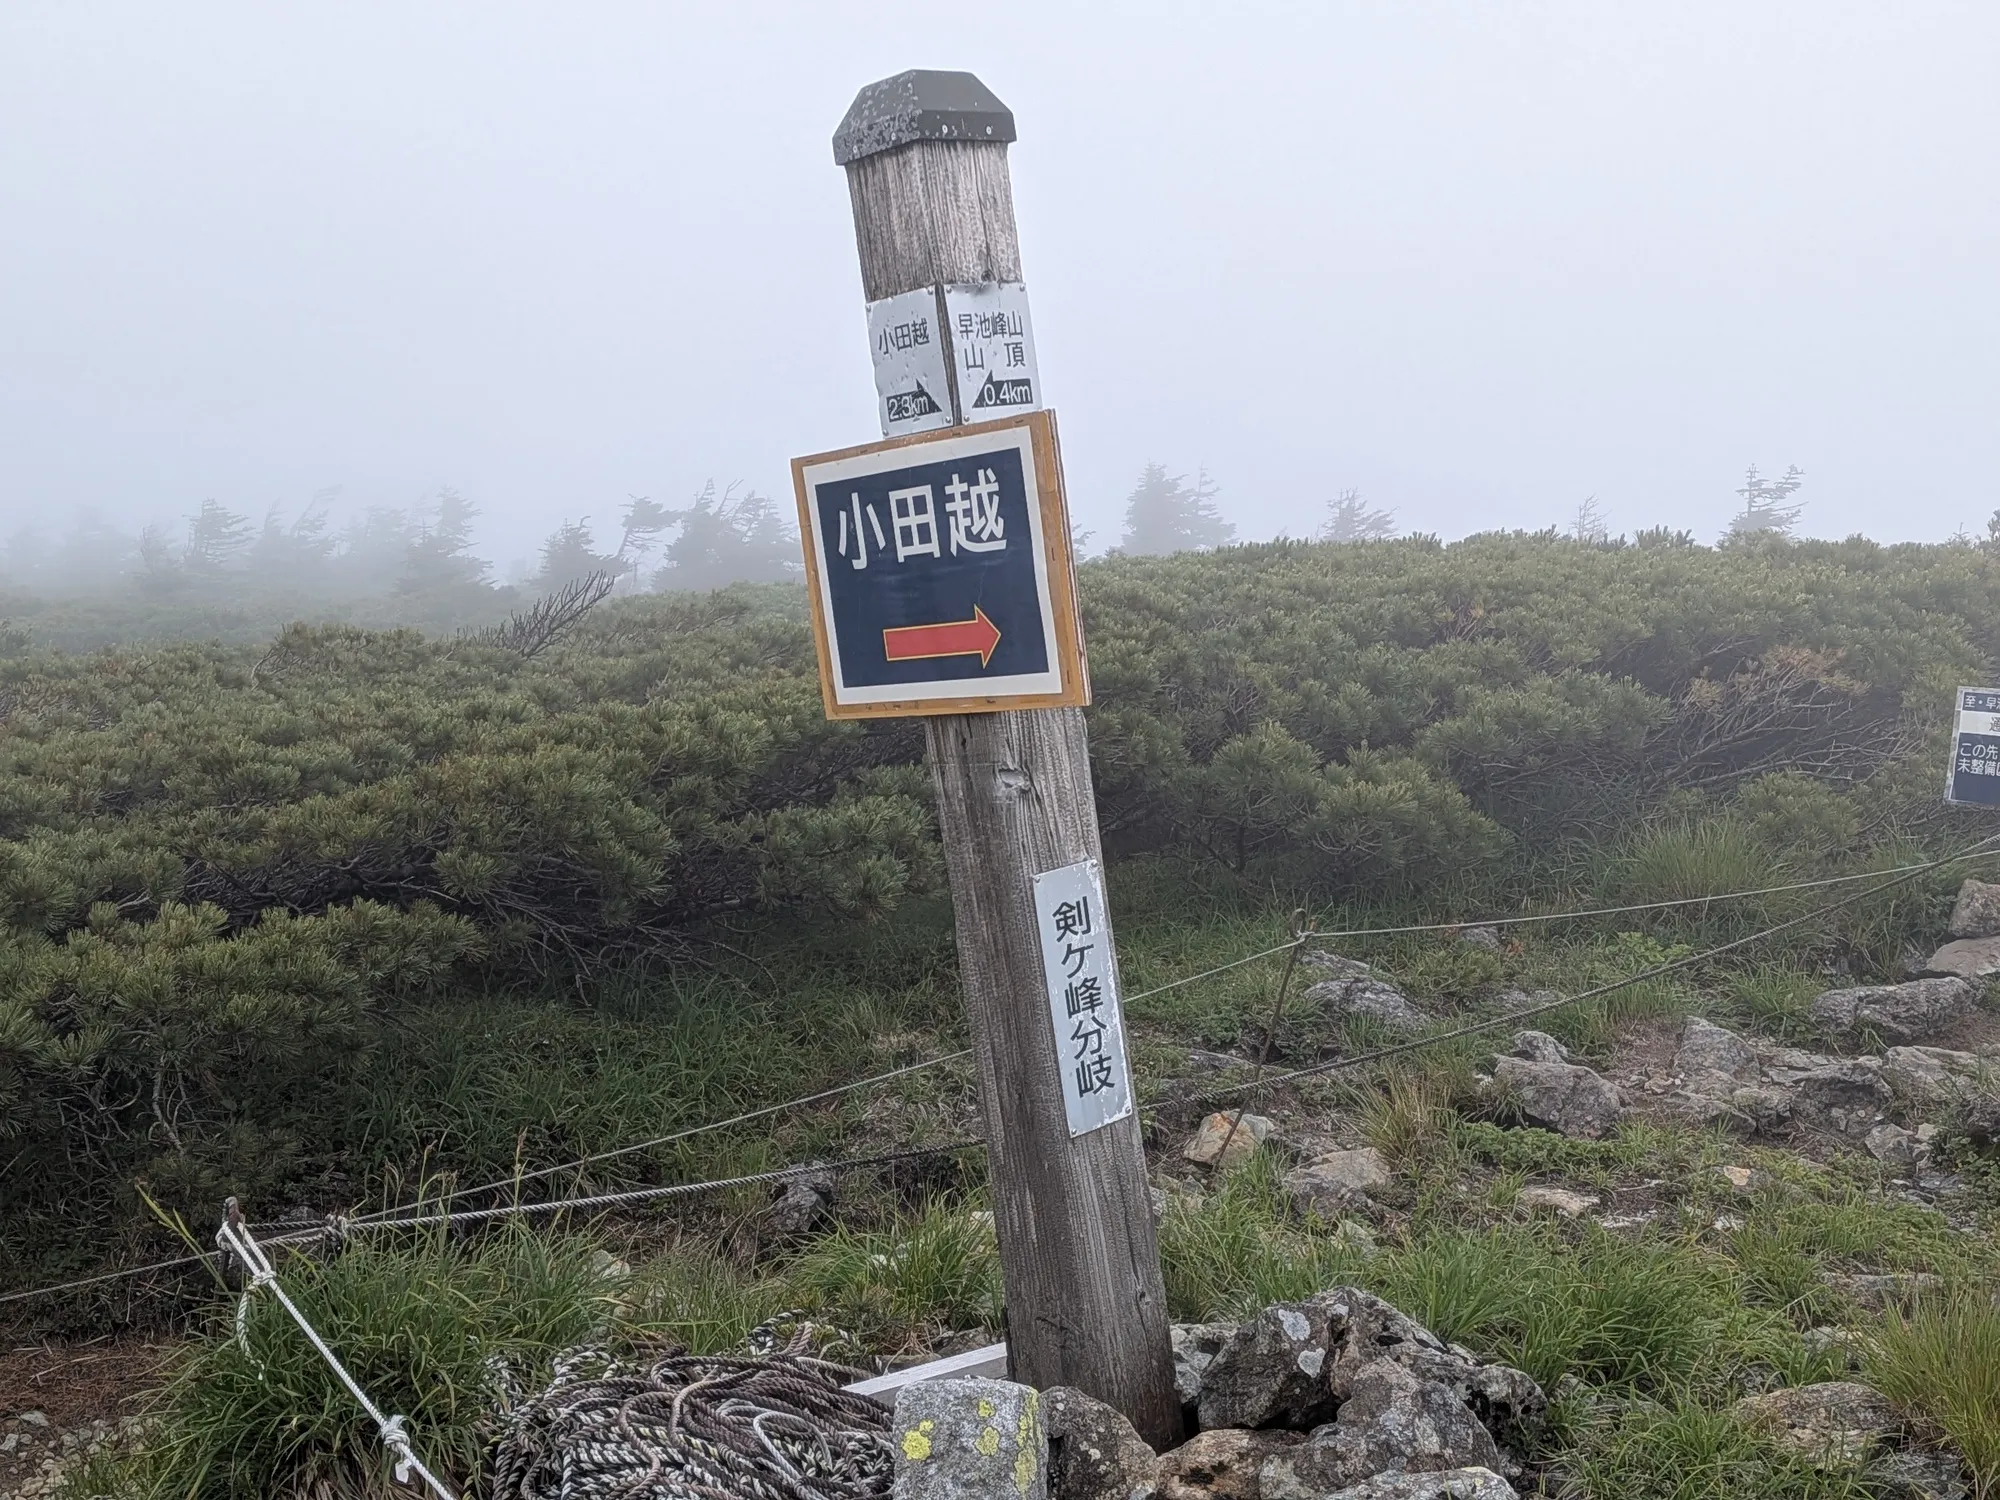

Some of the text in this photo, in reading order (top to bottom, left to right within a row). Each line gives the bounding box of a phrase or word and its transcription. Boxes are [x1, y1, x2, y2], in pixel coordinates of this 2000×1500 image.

[878, 317, 930, 356] 小田越
[958, 311, 1024, 340] 早池峰山
[984, 382, 1031, 405] 0.4km
[888, 395, 930, 421] 2.3km
[838, 467, 1007, 570] 小田越
[1960, 742, 1999, 760] この先
[1957, 758, 2000, 777] 未整備
